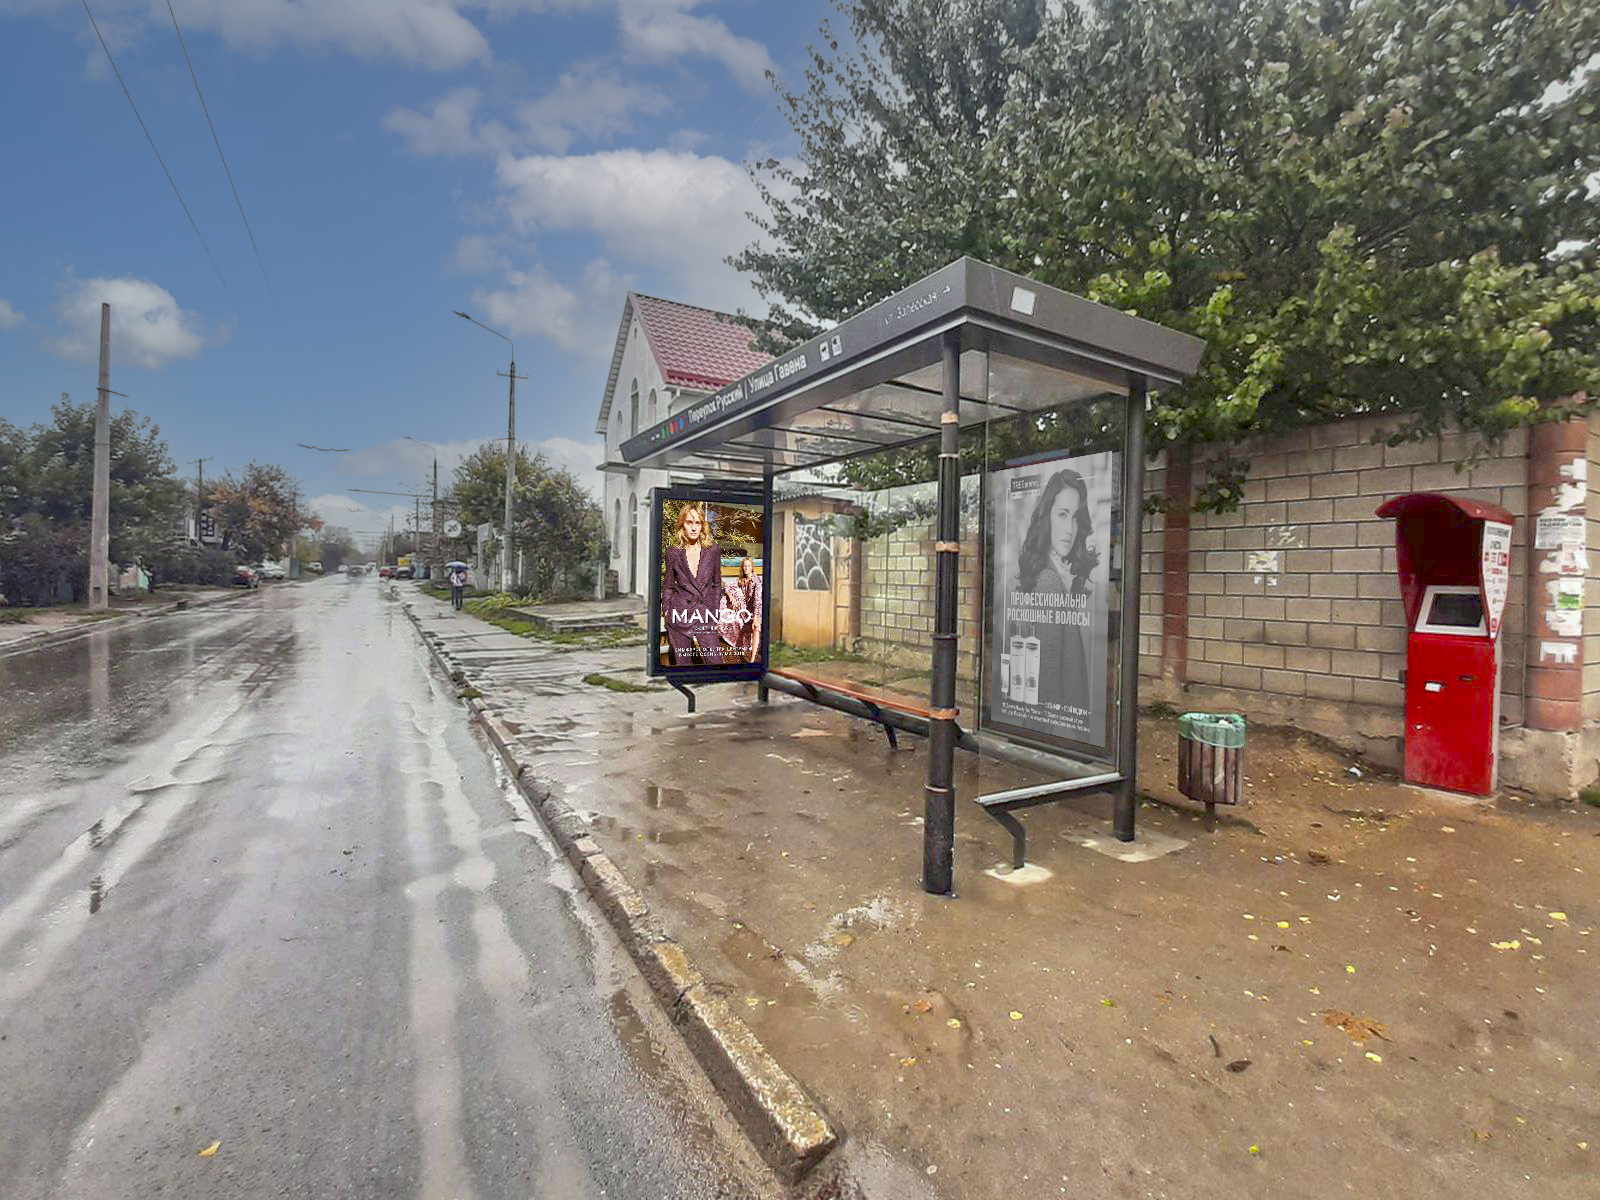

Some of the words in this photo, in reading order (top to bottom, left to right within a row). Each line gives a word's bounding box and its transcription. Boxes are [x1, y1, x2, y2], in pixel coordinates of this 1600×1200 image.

[688, 401, 716, 424] Переулок
[715, 383, 744, 412] Русский
[747, 371, 775, 394] Улица
[773, 354, 807, 381] Гавена
[1010, 592, 1087, 608] ПРОФЕССИОНАЛЬНО
[672, 608, 752, 624] MANGO
[1006, 607, 1054, 624] РОСКОШНЫЕ
[1055, 610, 1091, 627] ВОЛОСЫ
